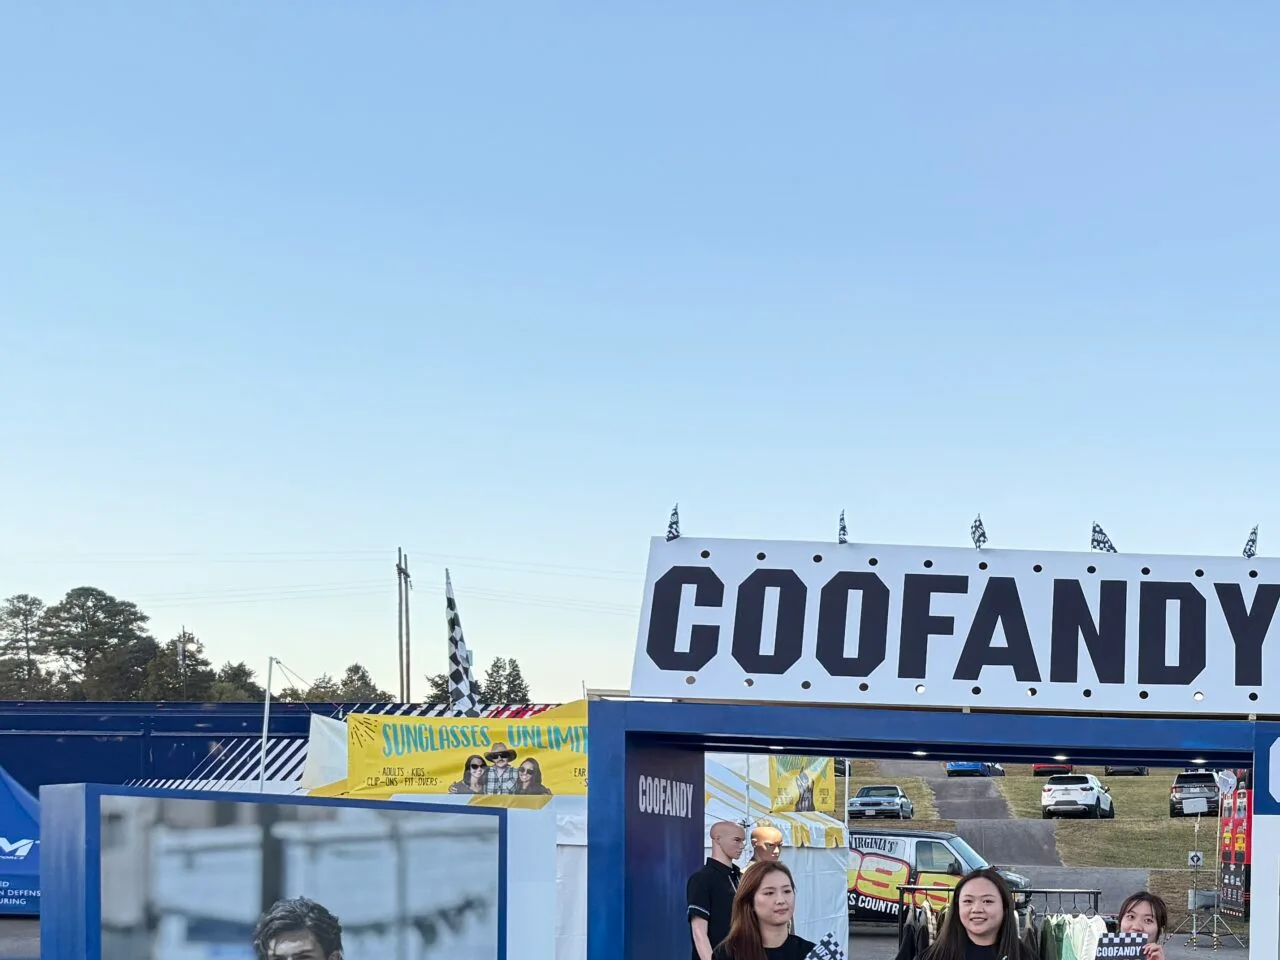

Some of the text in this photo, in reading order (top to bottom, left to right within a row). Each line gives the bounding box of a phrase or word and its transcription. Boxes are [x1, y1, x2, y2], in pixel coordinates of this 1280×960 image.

[382, 724, 490, 757] SUNGLASSES
[382, 767, 425, 777] ADULTS KIDS
[638, 774, 694, 818] COOFANDY
[858, 895, 906, 916] COUNTR
[1096, 945, 1142, 957] COOFANDY
